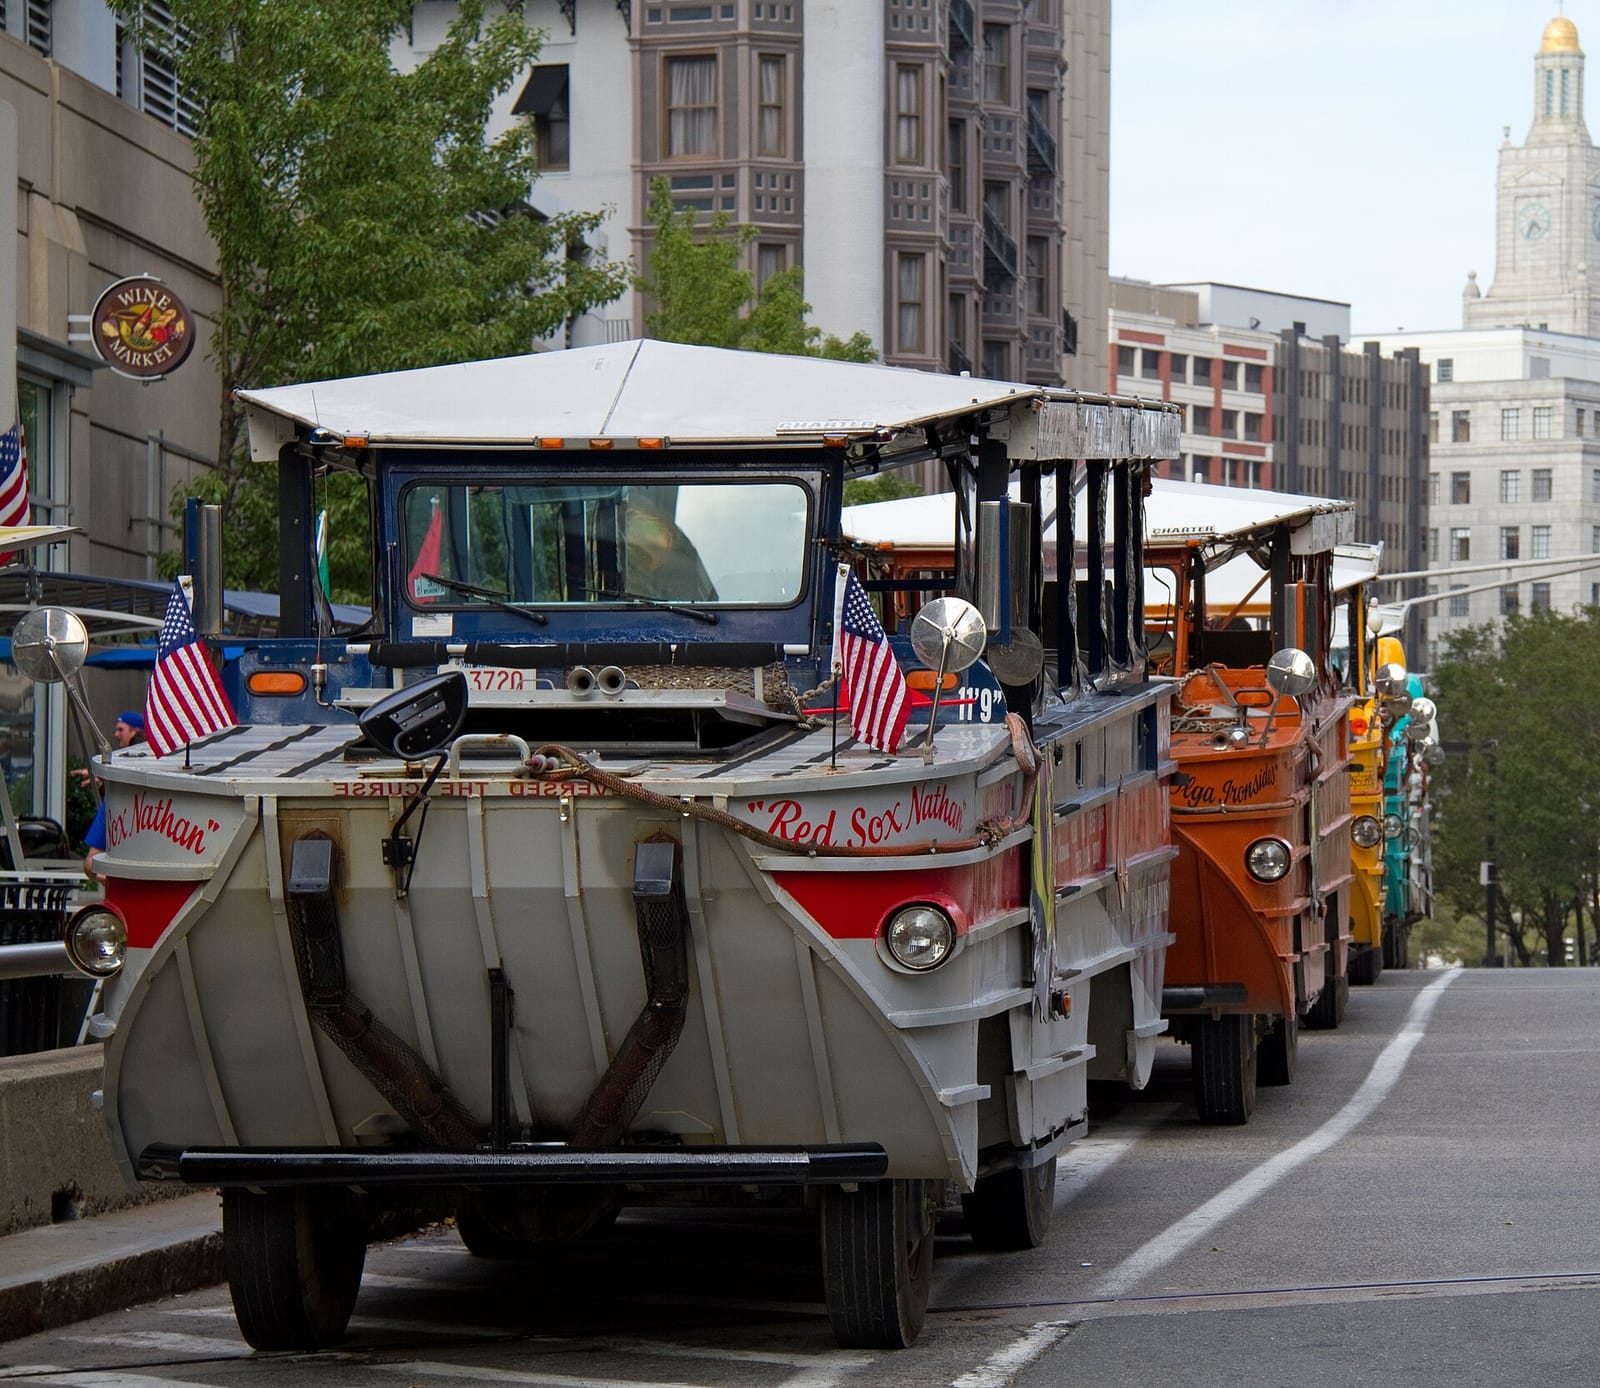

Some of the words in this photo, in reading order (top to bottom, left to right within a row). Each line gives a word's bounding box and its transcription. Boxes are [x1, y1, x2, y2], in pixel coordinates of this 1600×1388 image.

[117, 288, 171, 311] WINE
[110, 339, 173, 366] MARKET
[1152, 526, 1214, 534] CHARTER
[129, 790, 220, 855] Nathan"
[847, 807, 904, 847] Sox
